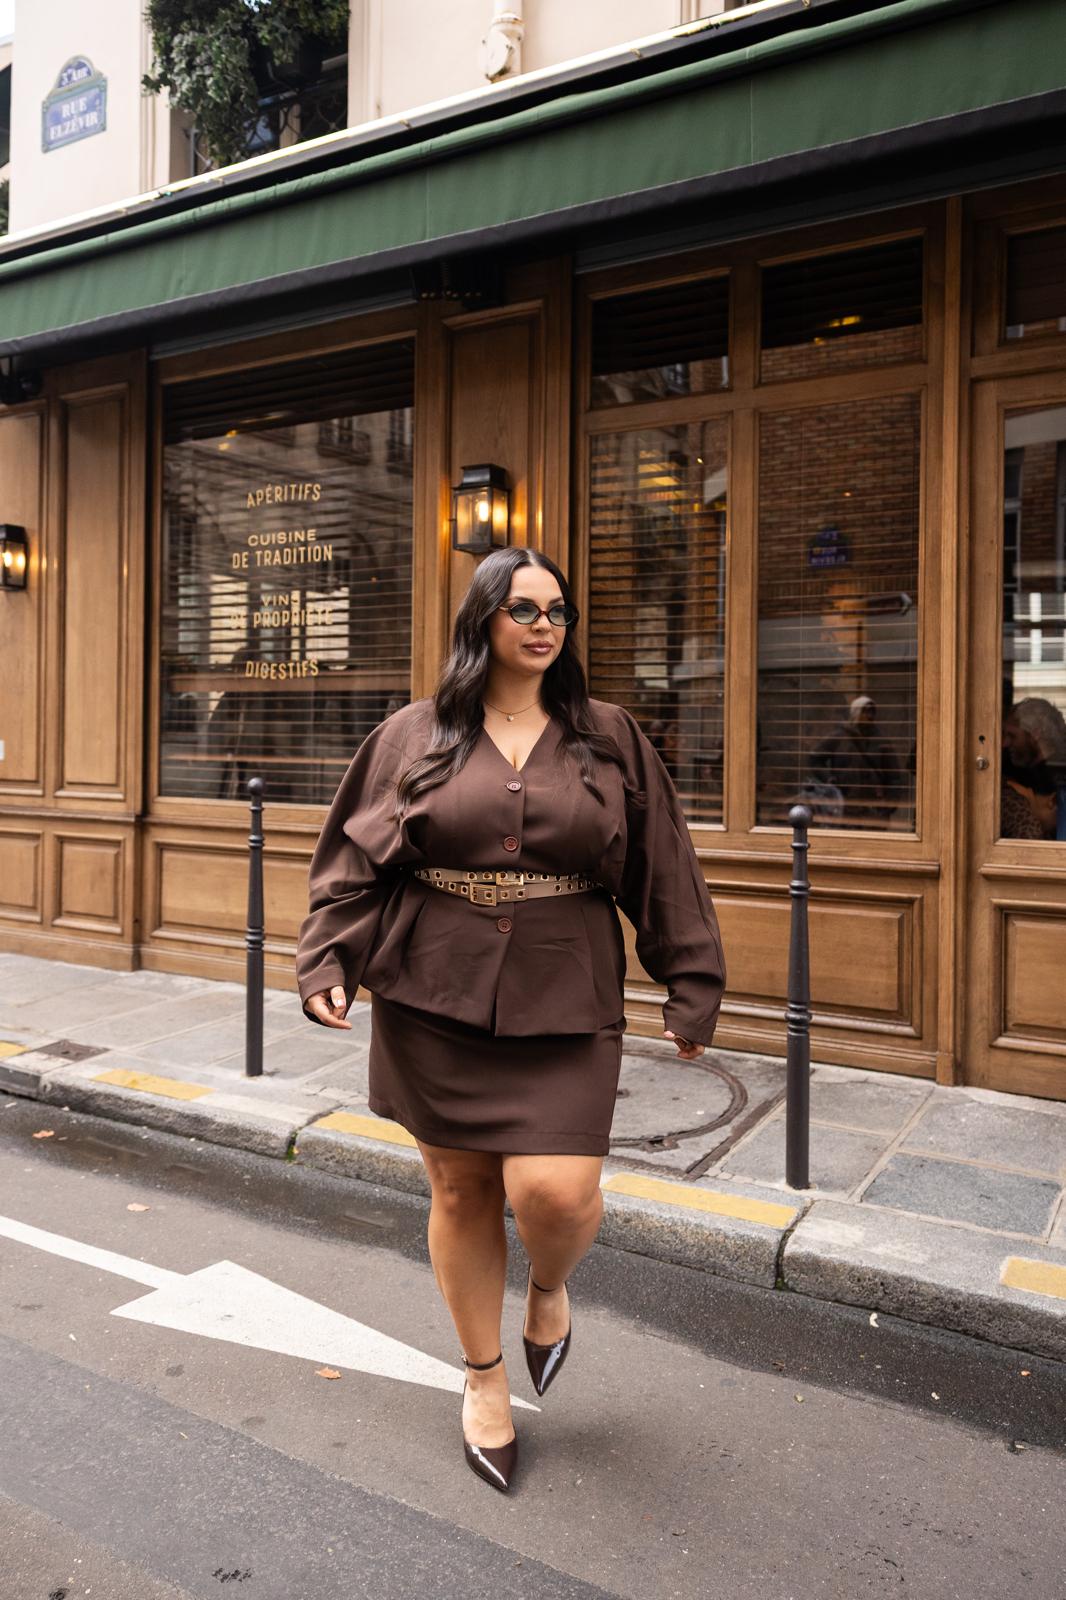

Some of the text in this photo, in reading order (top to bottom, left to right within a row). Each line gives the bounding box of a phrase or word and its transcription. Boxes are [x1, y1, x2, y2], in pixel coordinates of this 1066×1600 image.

[62, 97, 87, 118] RUE
[246, 483, 321, 509] APÉRITIFS
[247, 529, 317, 547] CUISINE
[232, 544, 333, 569] DE TRADITION
[245, 659, 319, 680] DIGESTIFS
